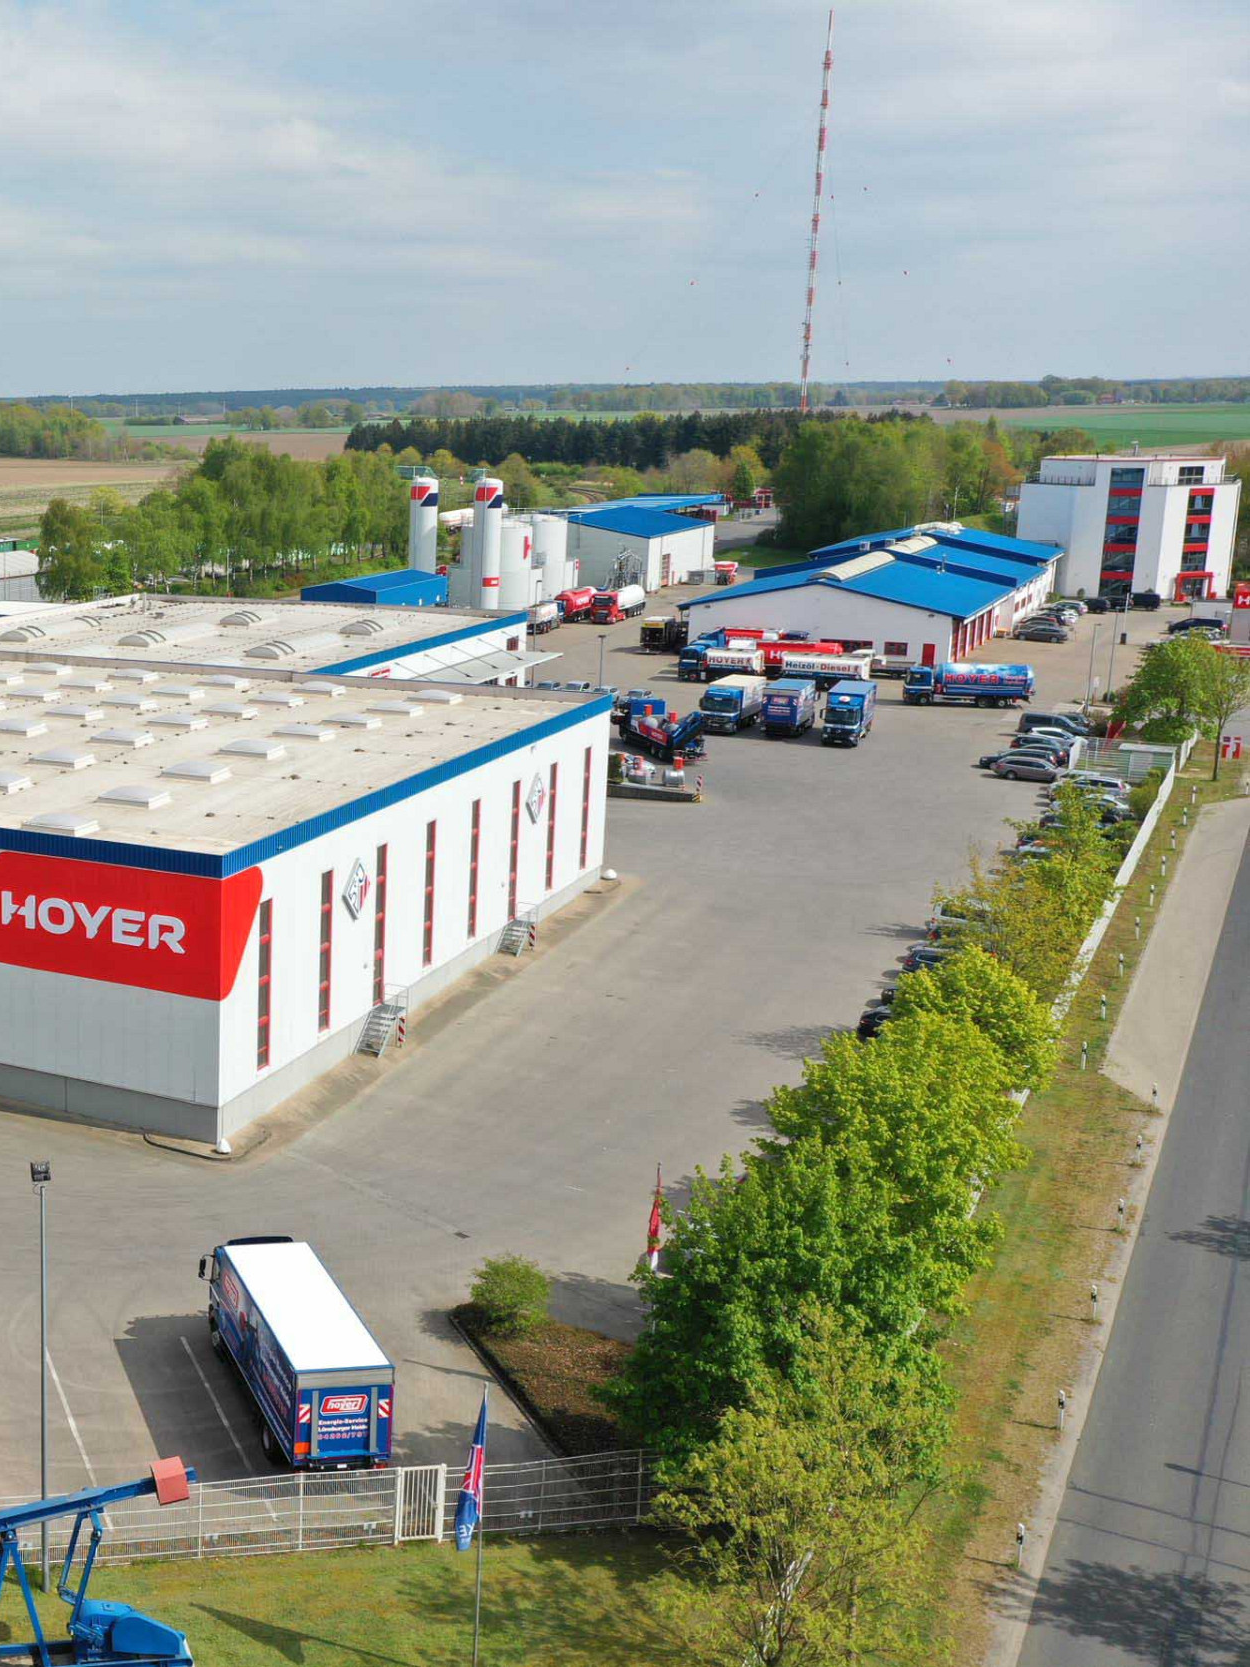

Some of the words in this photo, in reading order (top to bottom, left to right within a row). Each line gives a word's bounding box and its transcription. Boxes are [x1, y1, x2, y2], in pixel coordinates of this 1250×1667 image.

[708, 655, 745, 665] HOYER
[785, 660, 816, 670] Heizöl
[820, 663, 851, 672] Diesel
[945, 673, 1001, 685] HOYER
[0, 889, 187, 956] HOYER
